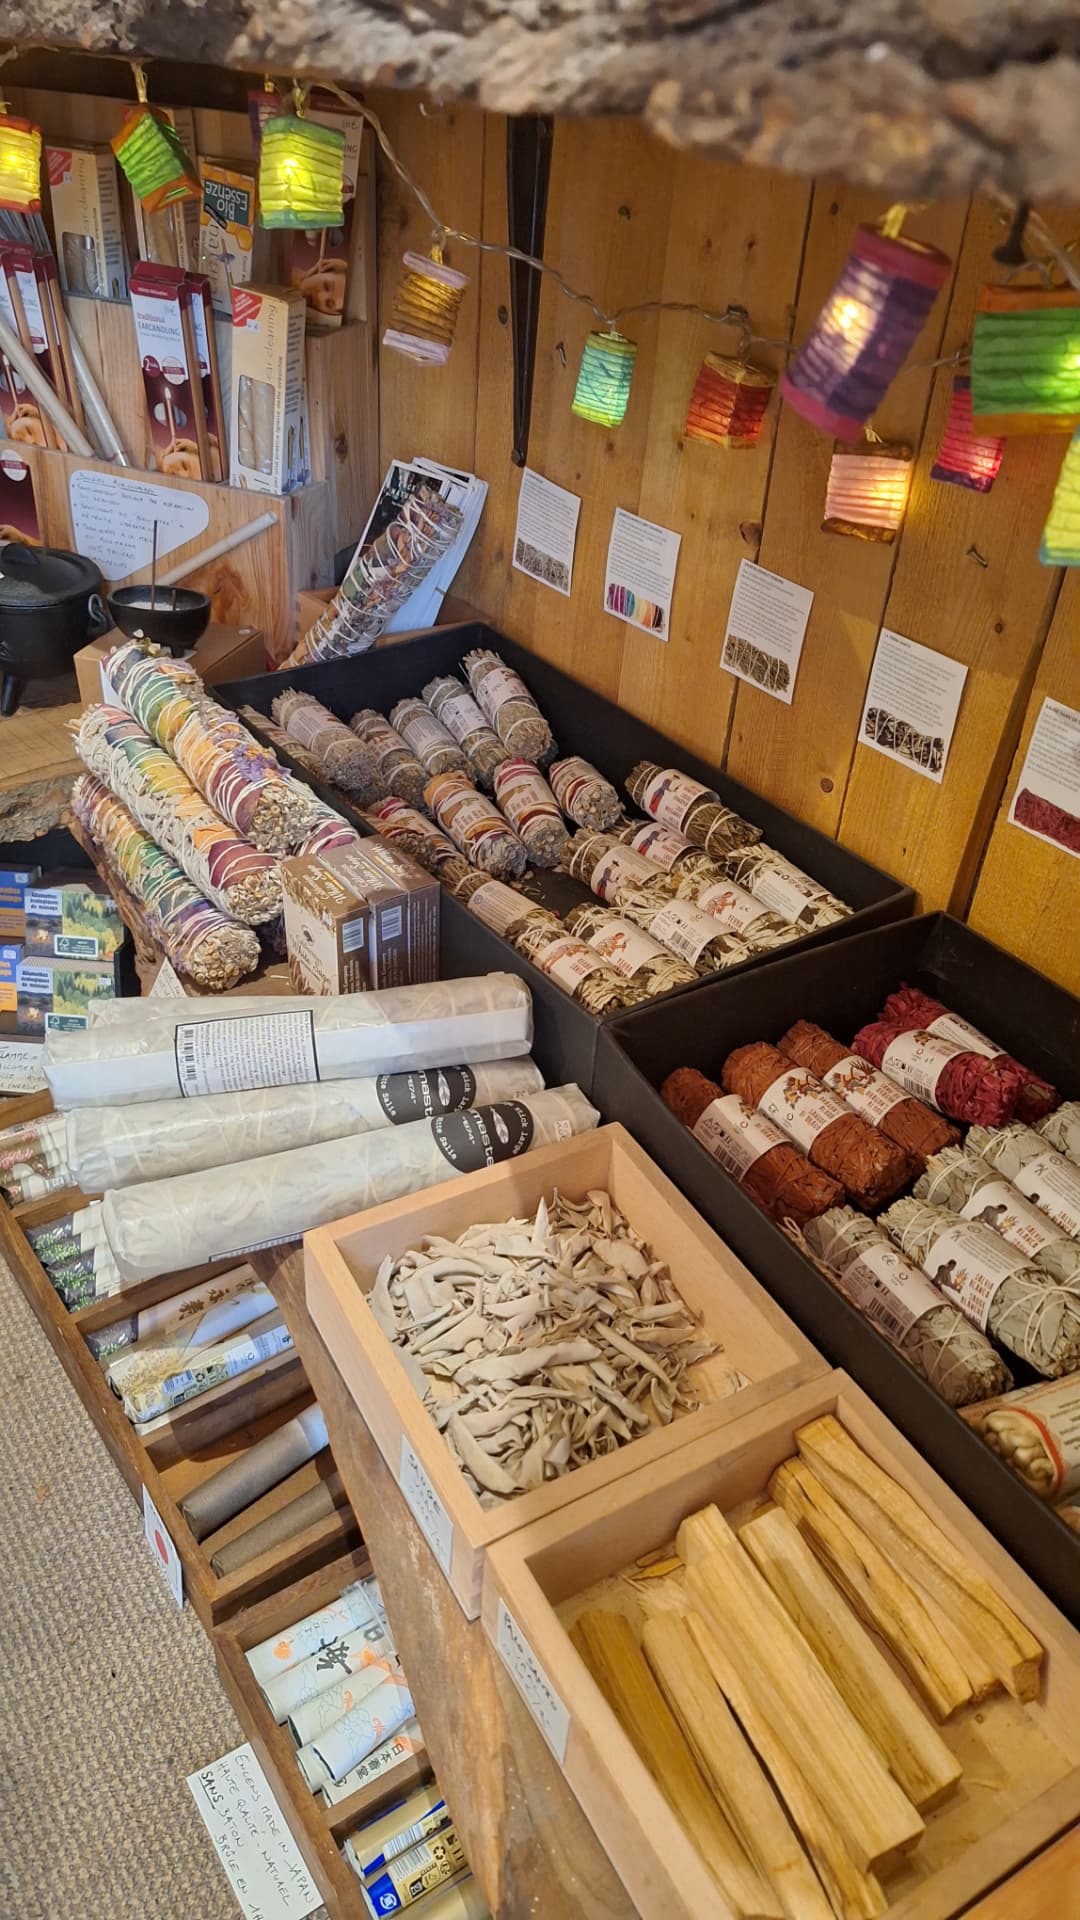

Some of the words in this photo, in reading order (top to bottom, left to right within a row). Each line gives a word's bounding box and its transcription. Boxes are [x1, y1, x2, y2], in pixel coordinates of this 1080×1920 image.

[205, 181, 248, 211] Essenze
[217, 199, 235, 220] Bio
[324, 880, 348, 904] White
[461, 1070, 472, 1093] stick
[382, 1092, 396, 1117] Salie
[514, 1107, 528, 1130] stick
[439, 1136, 457, 1160] Salie
[513, 1131, 528, 1155] large
[969, 1279, 990, 1299] BLANCA
[974, 1273, 994, 1290] SALVIA
[201, 1771, 224, 1804] SANS
[218, 1808, 244, 1848] BATON
[218, 1761, 240, 1795] HAUTE
[261, 1850, 292, 1907] NATUREL
[234, 1754, 262, 1802] ENCENS
[261, 1805, 280, 1836] MADE
[278, 1840, 289, 1853] IN
[284, 1859, 313, 1903] JAPAN
[215, 1834, 241, 1873] BRÛLE
[237, 1878, 249, 1895] EN
